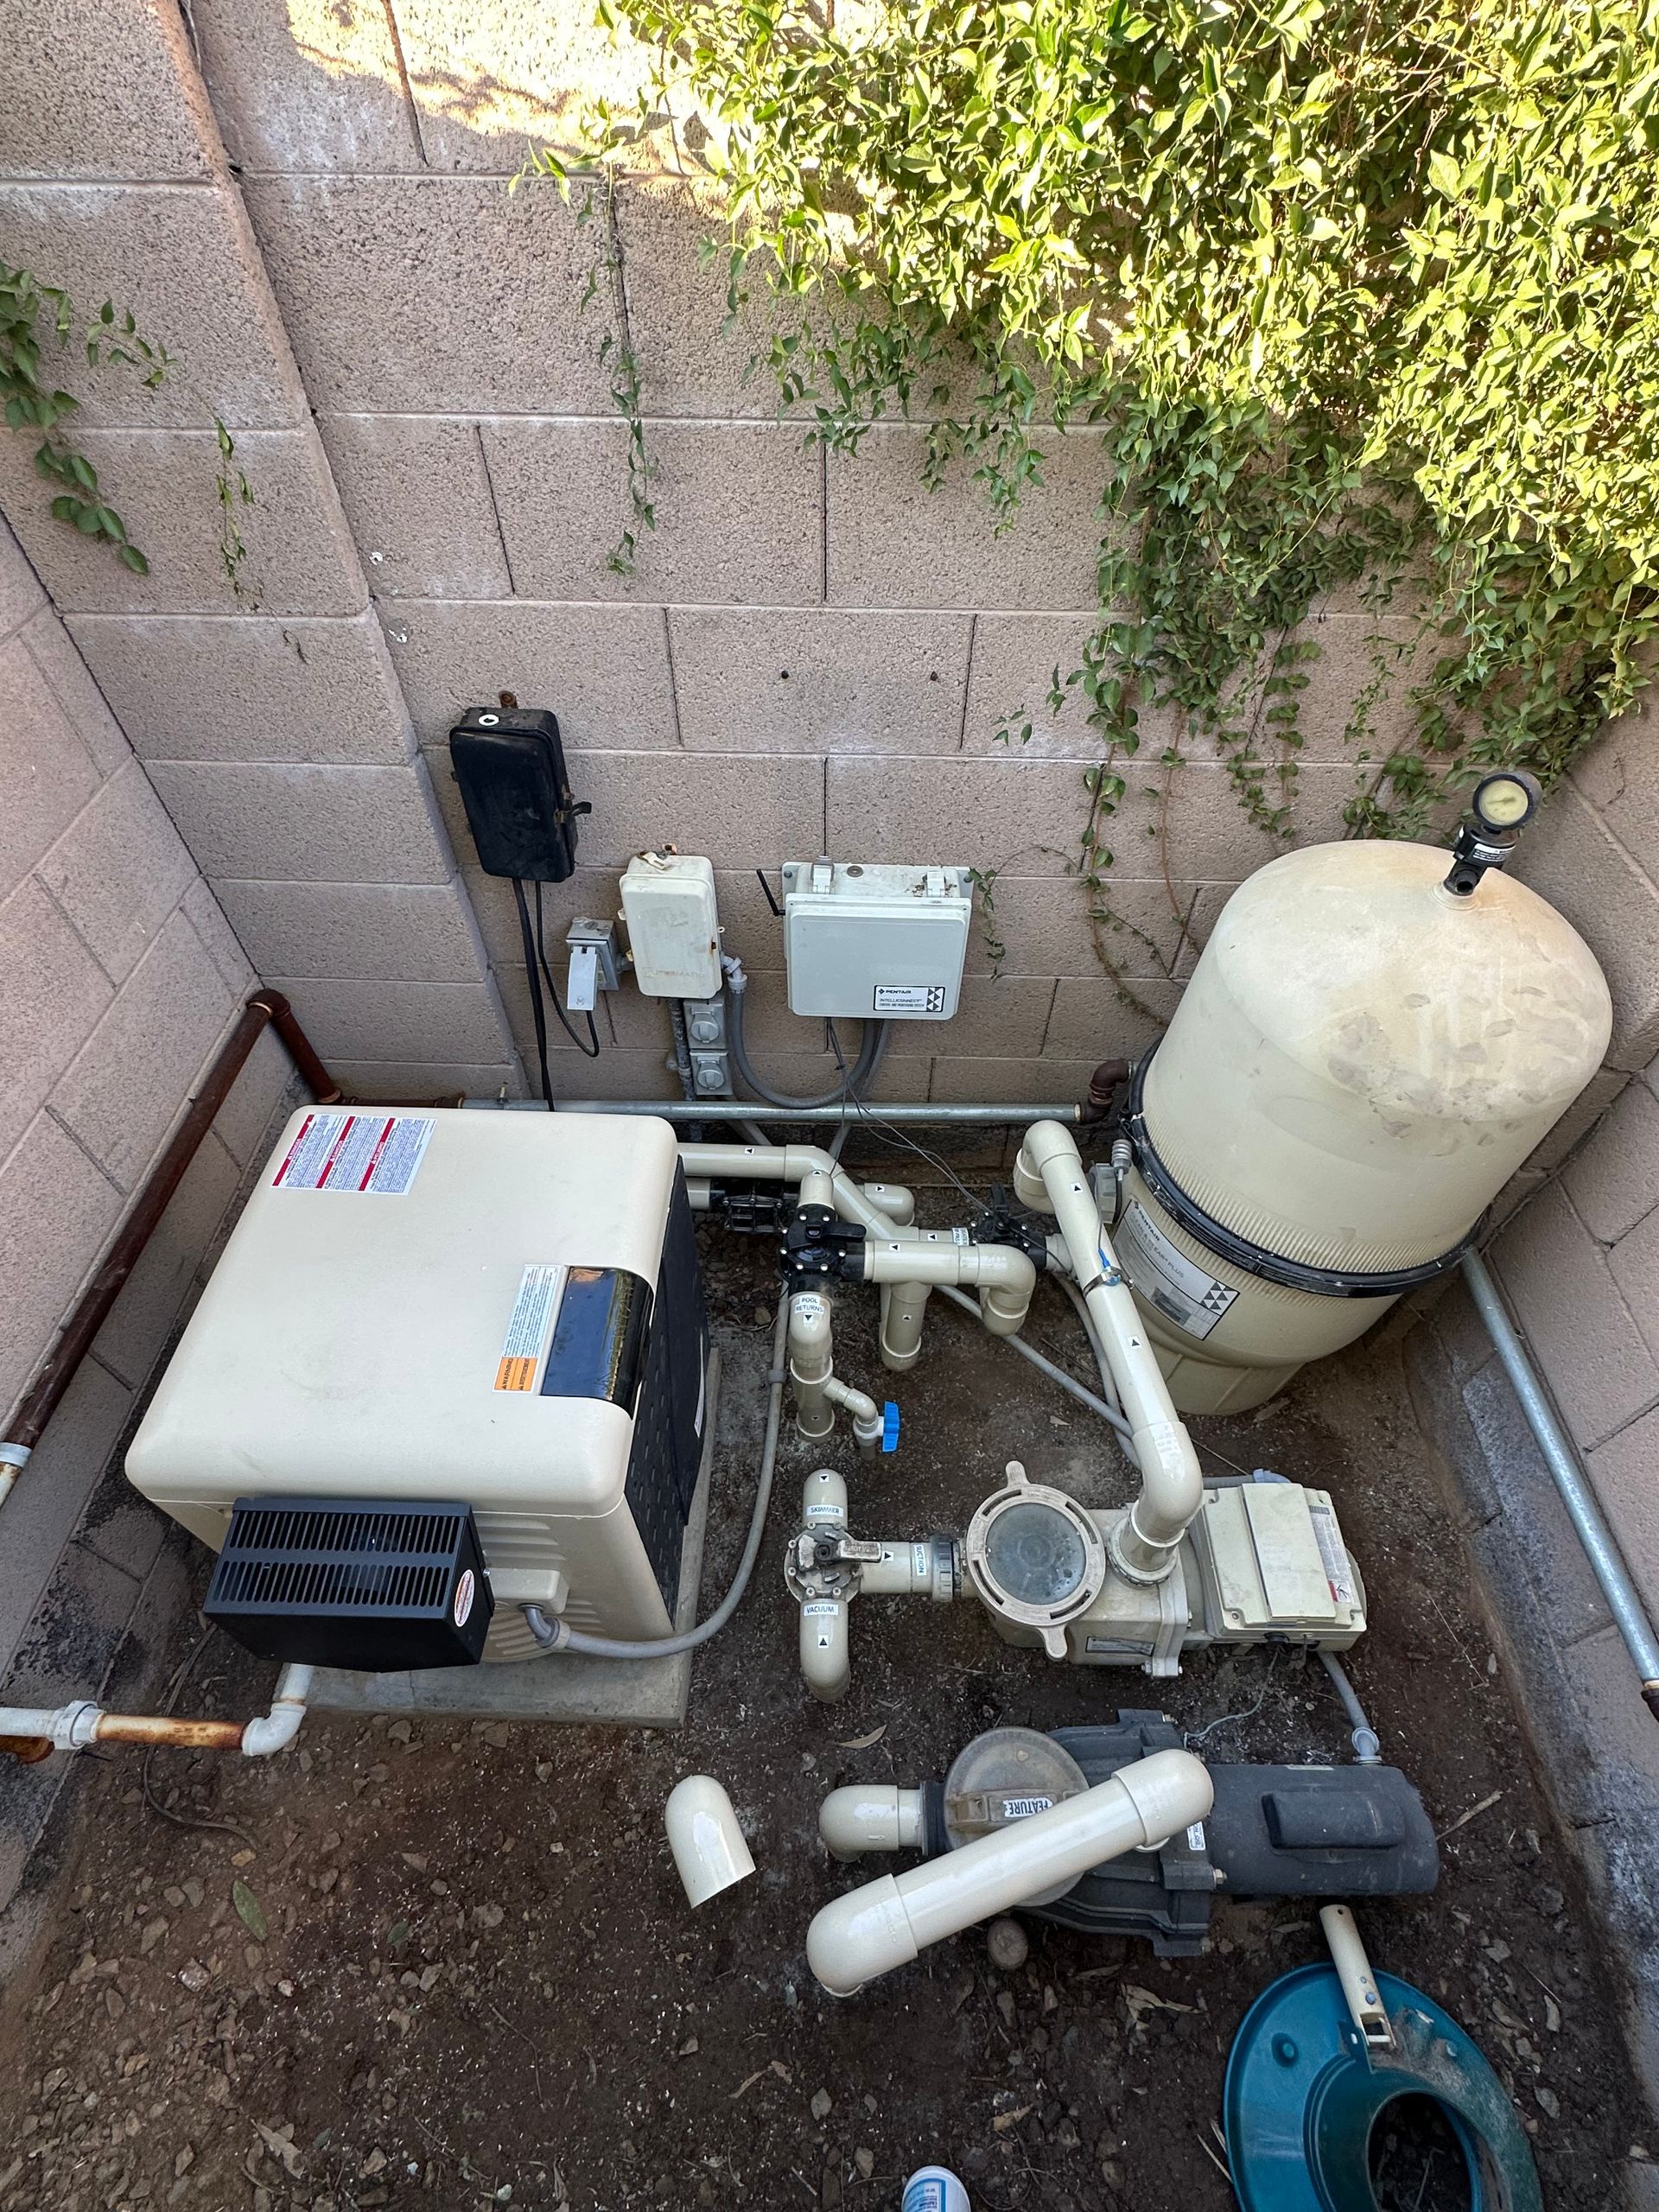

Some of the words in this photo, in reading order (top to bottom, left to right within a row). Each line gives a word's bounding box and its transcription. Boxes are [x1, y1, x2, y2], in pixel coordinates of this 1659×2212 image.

[1139, 1210, 1160, 1241] PENTAIR
[915, 1546, 925, 1573] SUCTION
[1008, 1800, 1049, 1815] FEATURE
